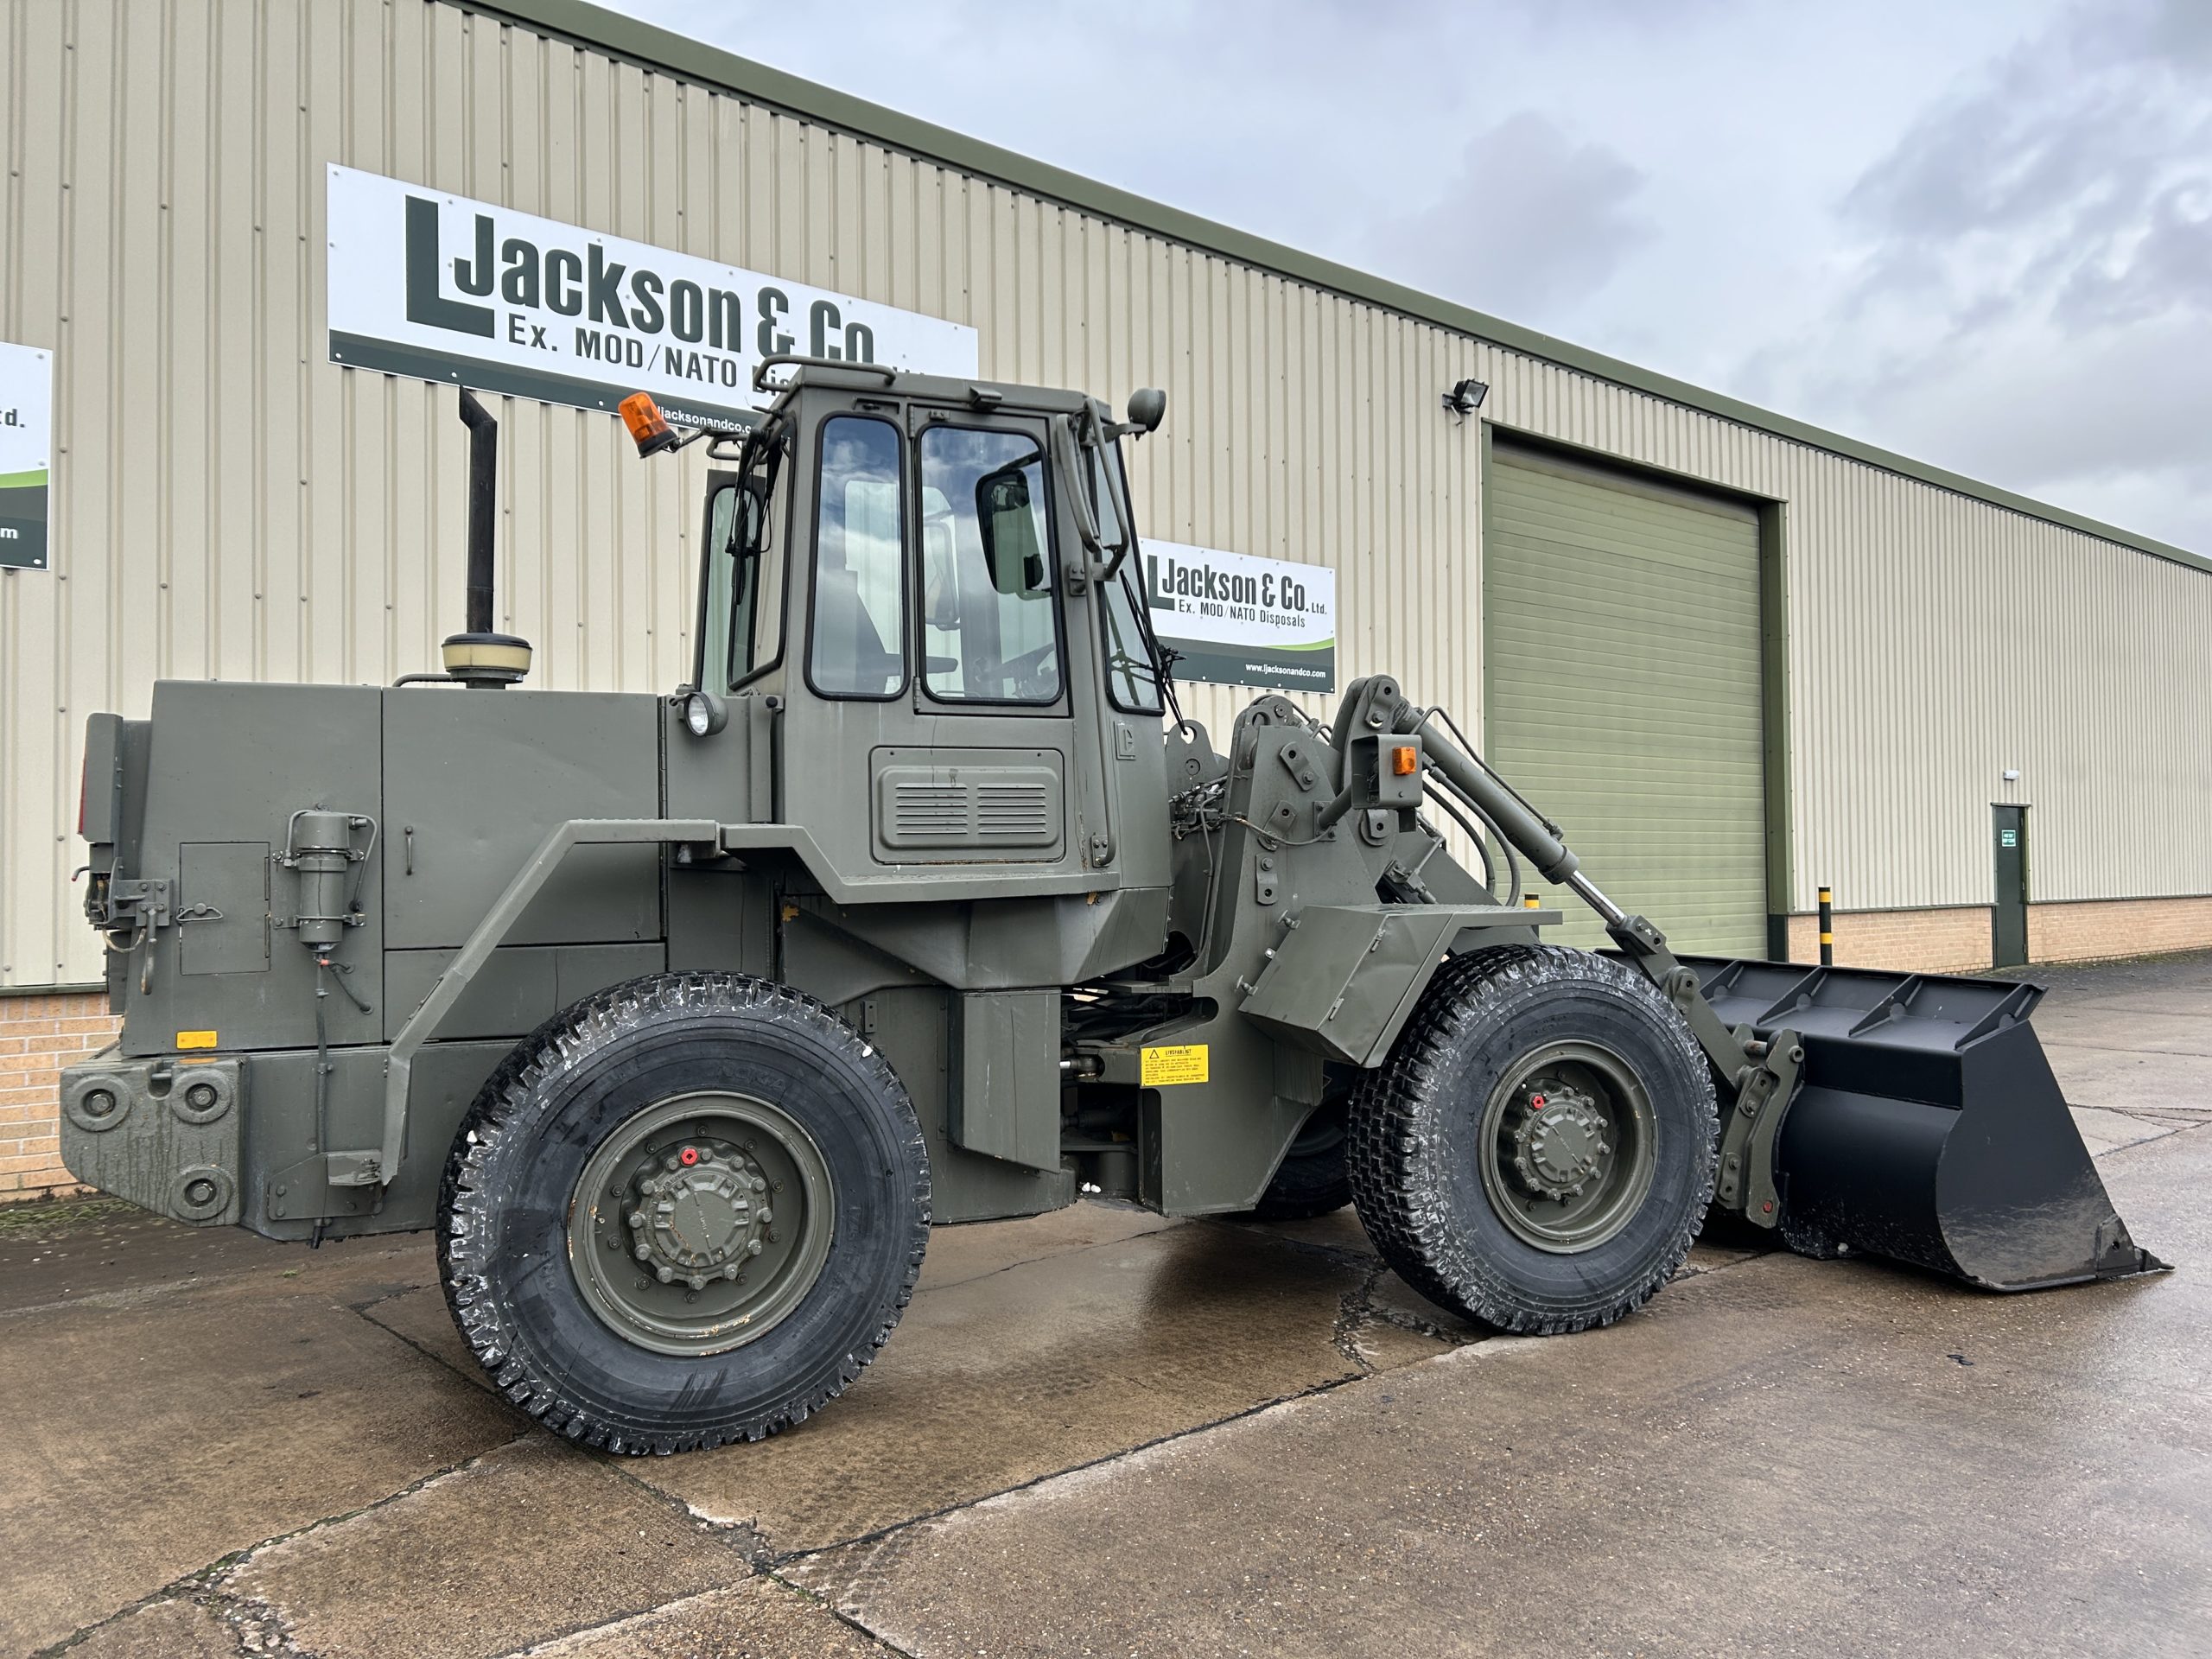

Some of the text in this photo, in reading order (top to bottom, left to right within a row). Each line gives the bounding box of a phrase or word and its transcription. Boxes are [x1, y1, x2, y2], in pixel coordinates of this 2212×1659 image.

[757, 286, 795, 359] &
[508, 314, 557, 352] Ex.
[575, 327, 737, 389] MOD/NATO
[1179, 599, 1306, 627] Ex. MOD/NATO Disposals
[1262, 573, 1275, 607] &
[1281, 575, 1309, 613] Co.
[1312, 602, 1327, 615] Ltd.
[1245, 664, 1326, 678] www.ljacksonandco.com
